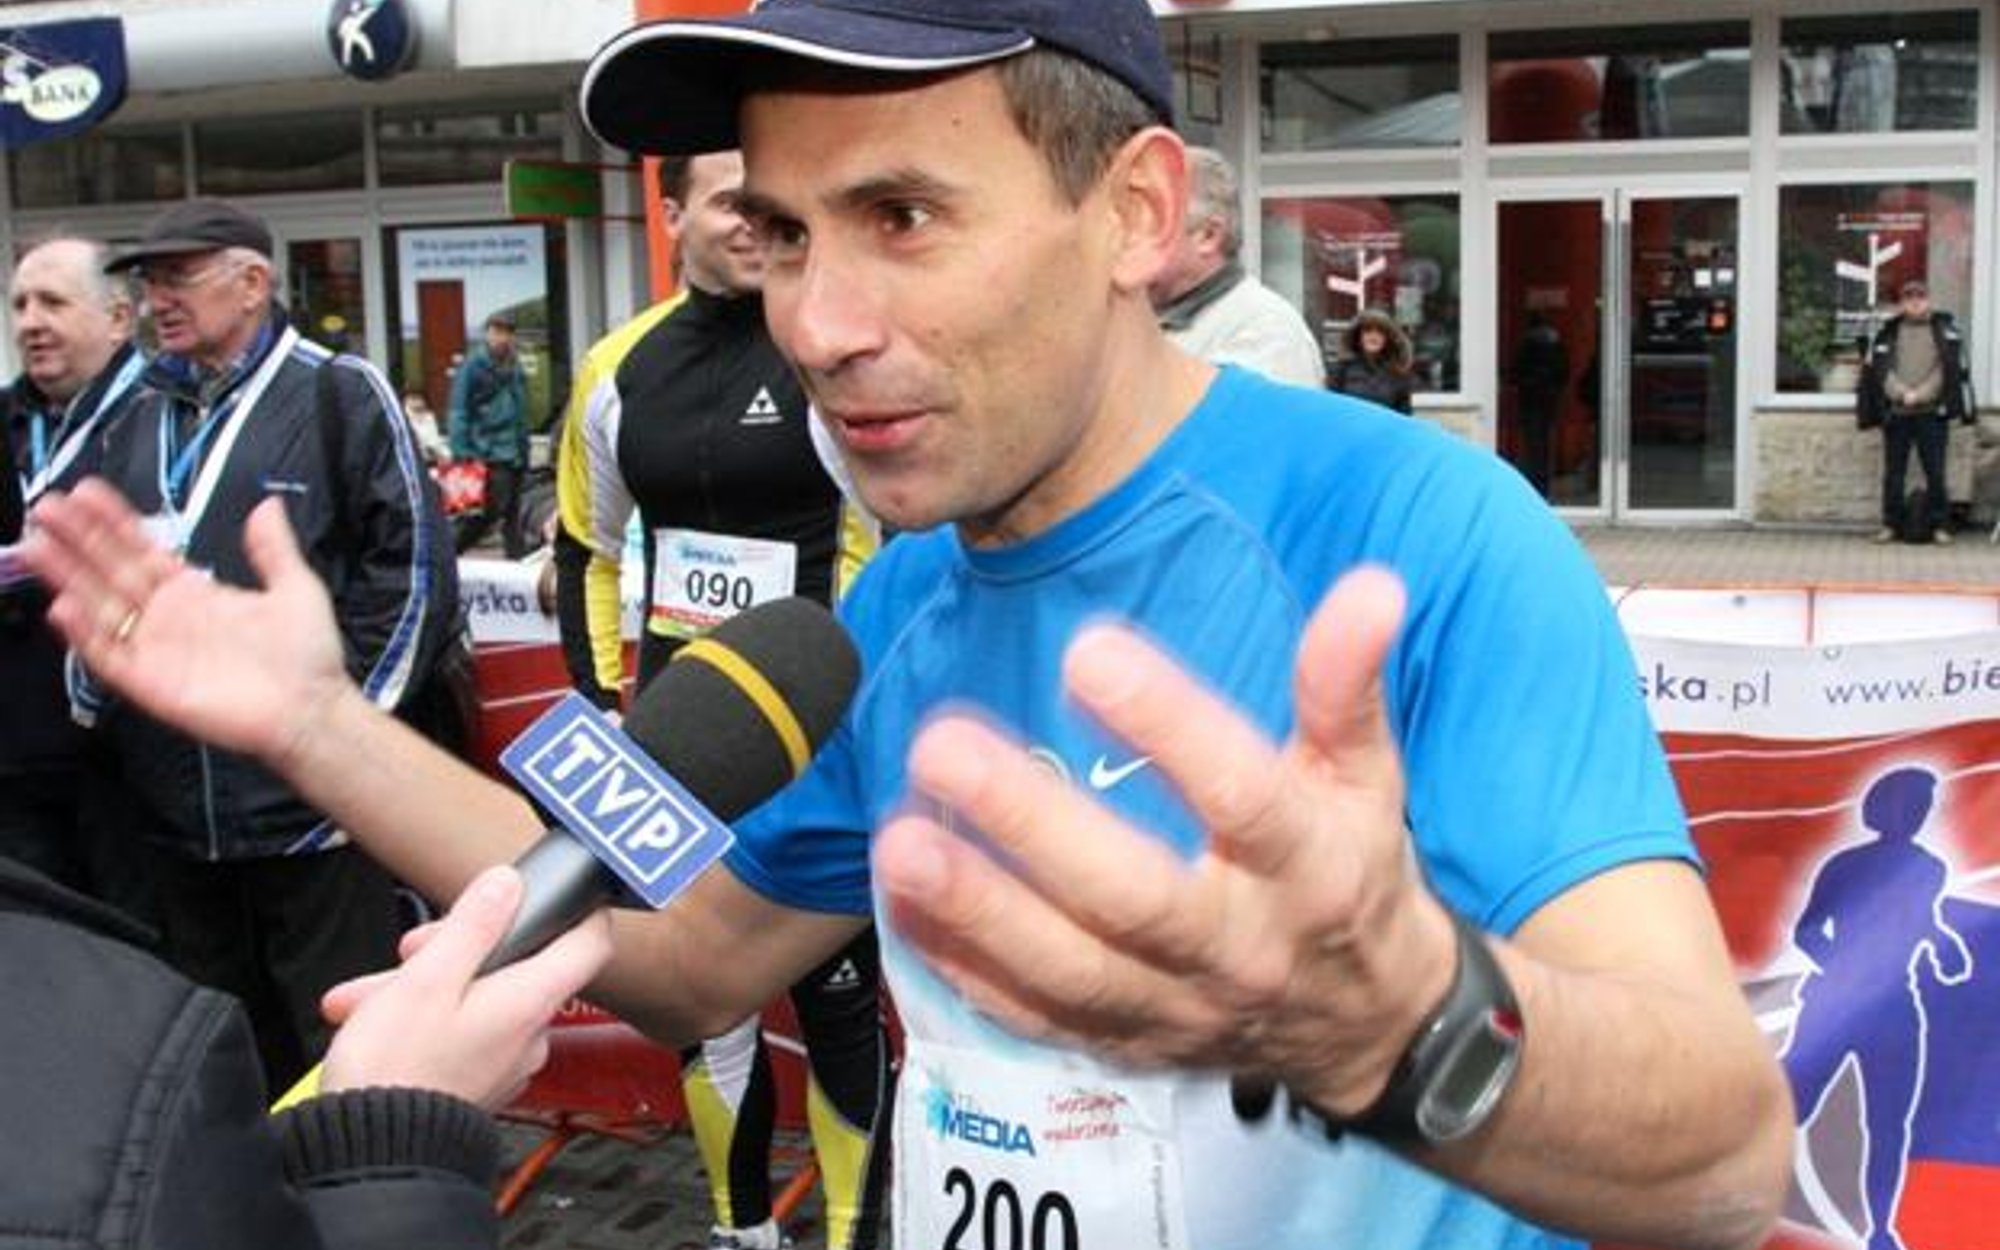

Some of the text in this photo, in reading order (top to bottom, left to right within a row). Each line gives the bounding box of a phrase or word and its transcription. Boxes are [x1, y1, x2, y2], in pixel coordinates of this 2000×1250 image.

[31, 83, 90, 105] BANK
[686, 569, 753, 610] 090
[552, 732, 681, 850] TVP
[943, 1102, 1036, 1157] MEDIA
[942, 1166, 1079, 1250] 200
